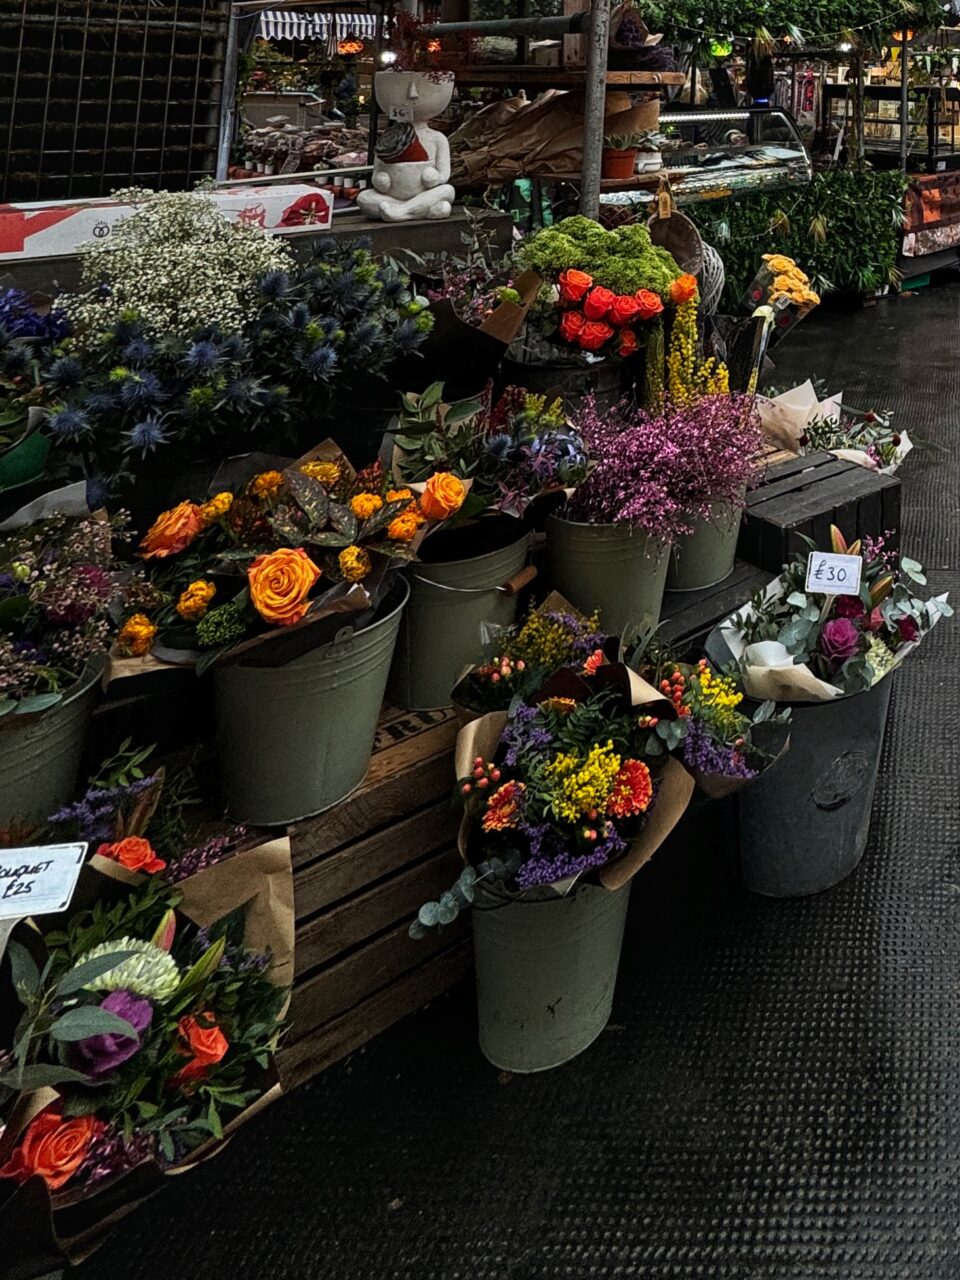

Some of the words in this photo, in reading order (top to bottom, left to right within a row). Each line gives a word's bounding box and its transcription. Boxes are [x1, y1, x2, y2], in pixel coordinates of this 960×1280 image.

[813, 559, 847, 582] £30
[0, 860, 54, 879] OUQUET
[2, 879, 36, 899] £25
